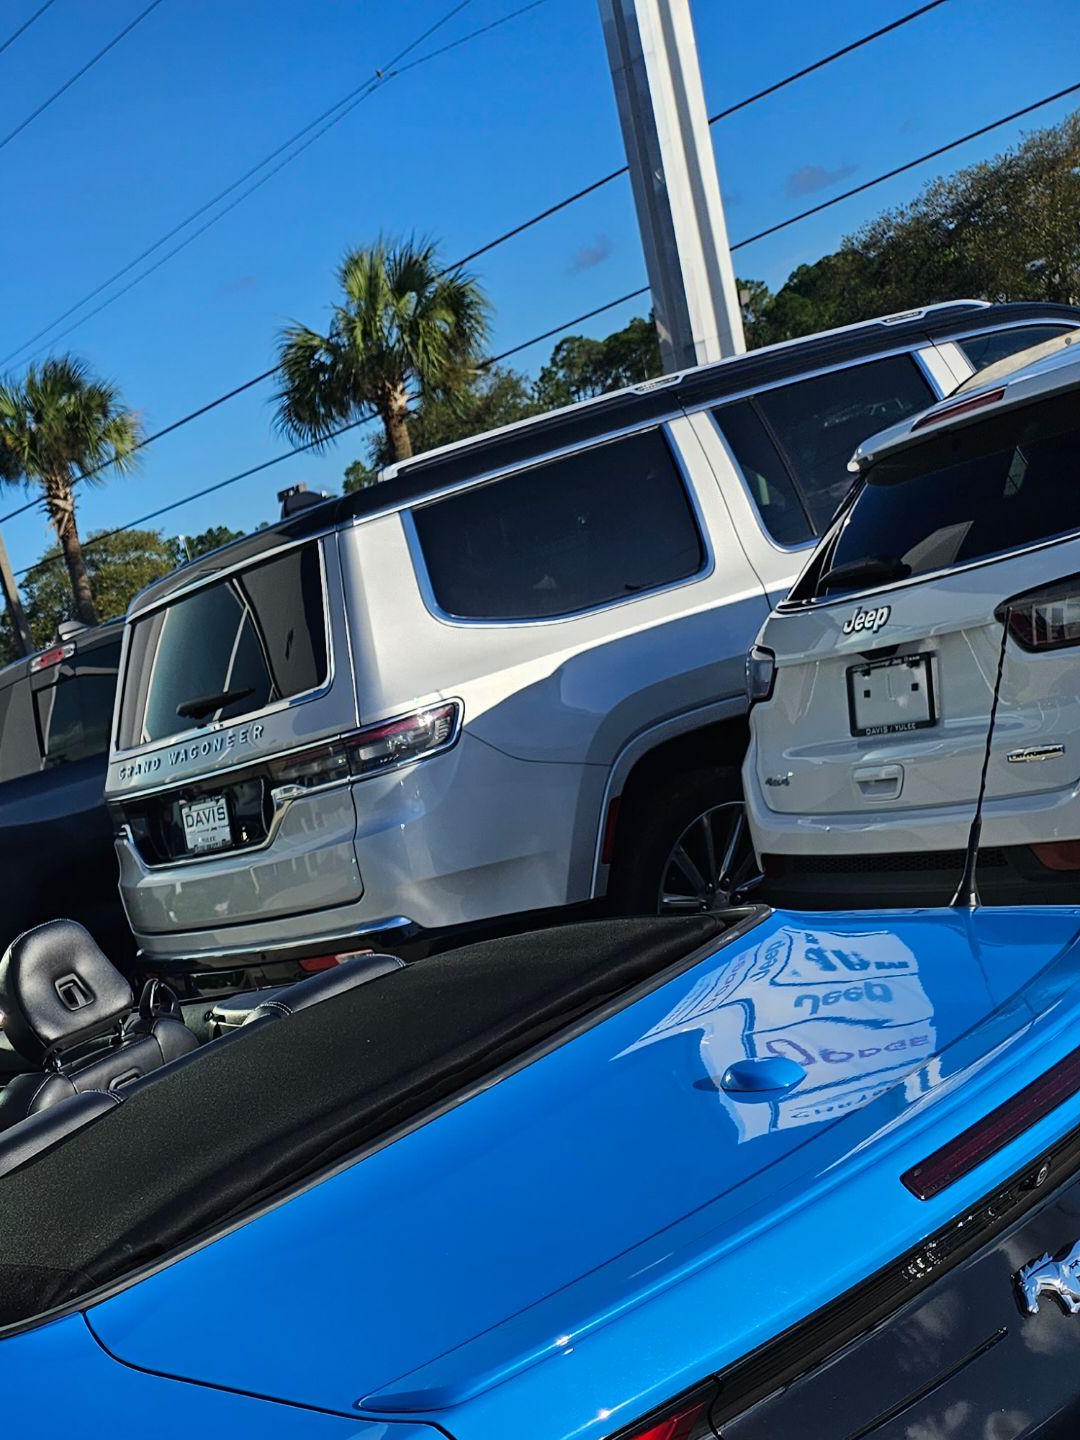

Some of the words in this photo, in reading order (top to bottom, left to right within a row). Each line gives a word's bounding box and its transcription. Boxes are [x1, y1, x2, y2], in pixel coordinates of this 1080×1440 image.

[842, 605, 892, 634] Jeep
[865, 725, 888, 735] DAVIS
[118, 760, 161, 781] GRAND
[168, 724, 265, 766] WAGONEER
[185, 806, 226, 829] DAVIS
